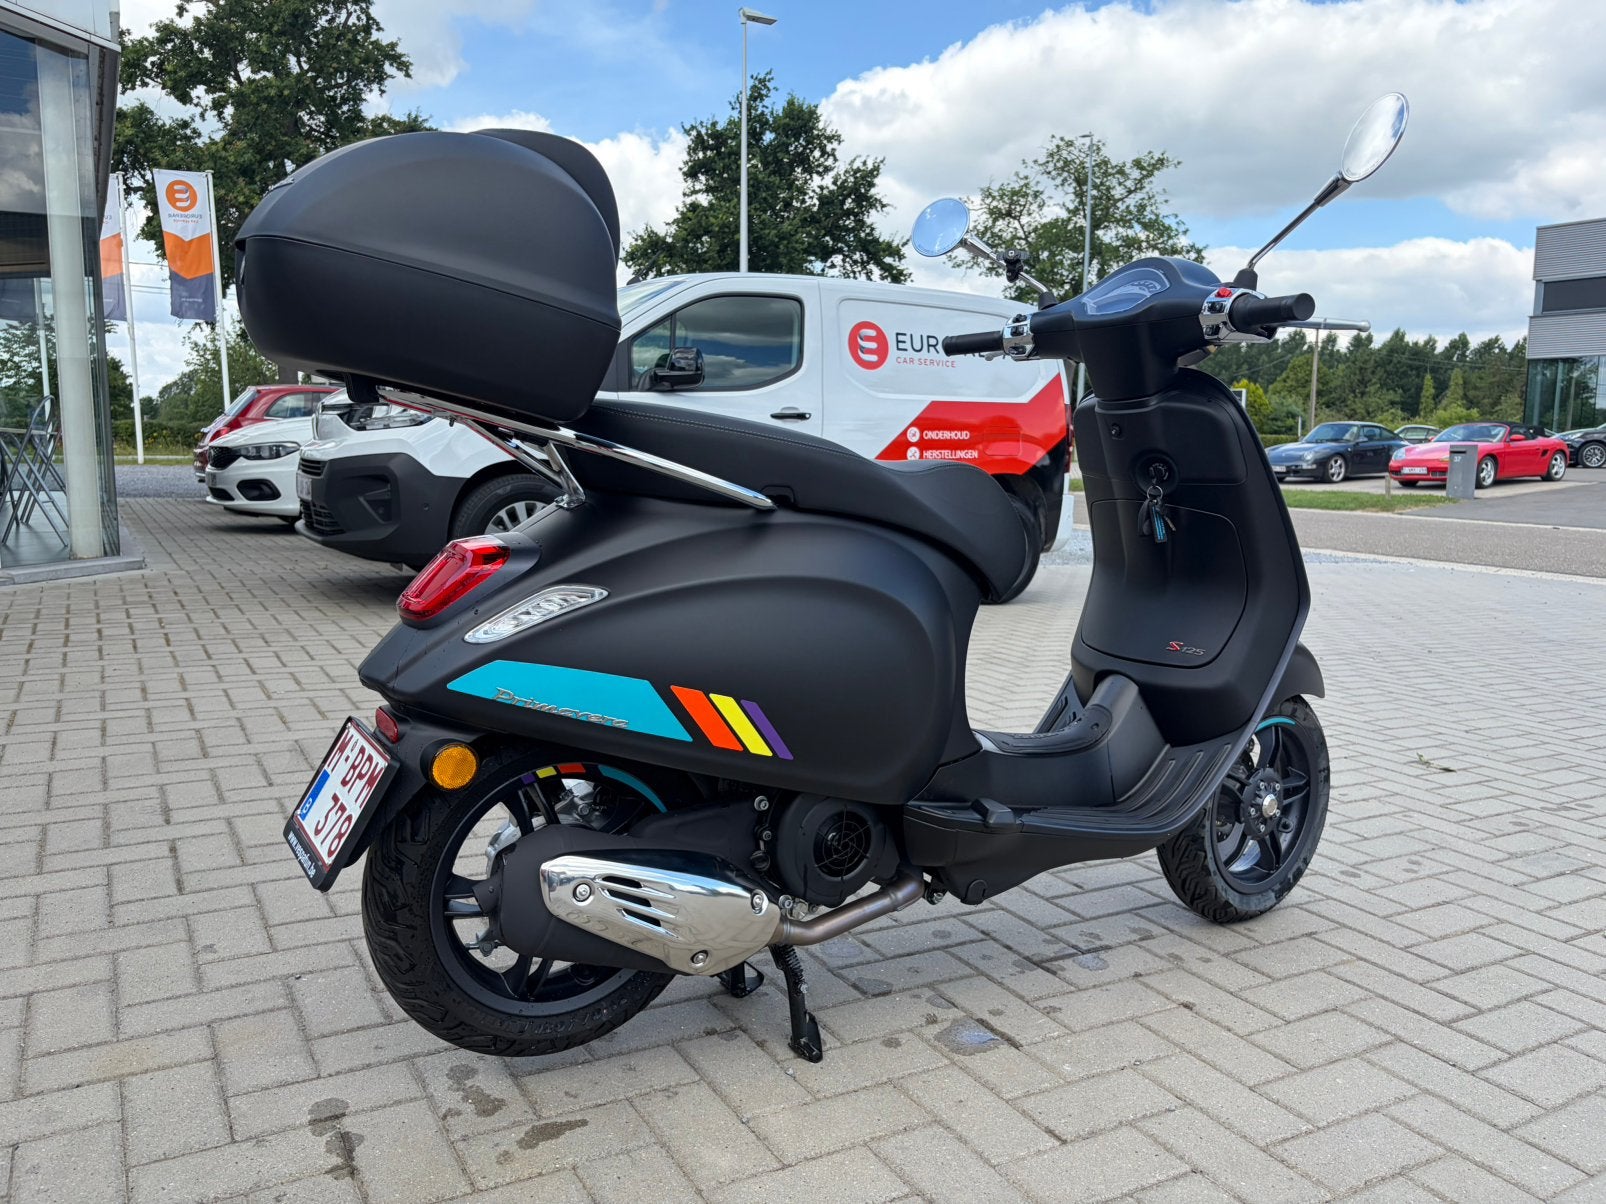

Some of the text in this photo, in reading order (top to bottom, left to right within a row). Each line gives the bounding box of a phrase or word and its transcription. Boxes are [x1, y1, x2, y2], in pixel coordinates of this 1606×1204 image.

[896, 356, 957, 368] CAR SERVICE
[923, 430, 970, 440] ONDERHOUD
[922, 449, 979, 459] HERSTELLINGEN
[494, 686, 629, 729] Primavera
[314, 792, 353, 859] 378
